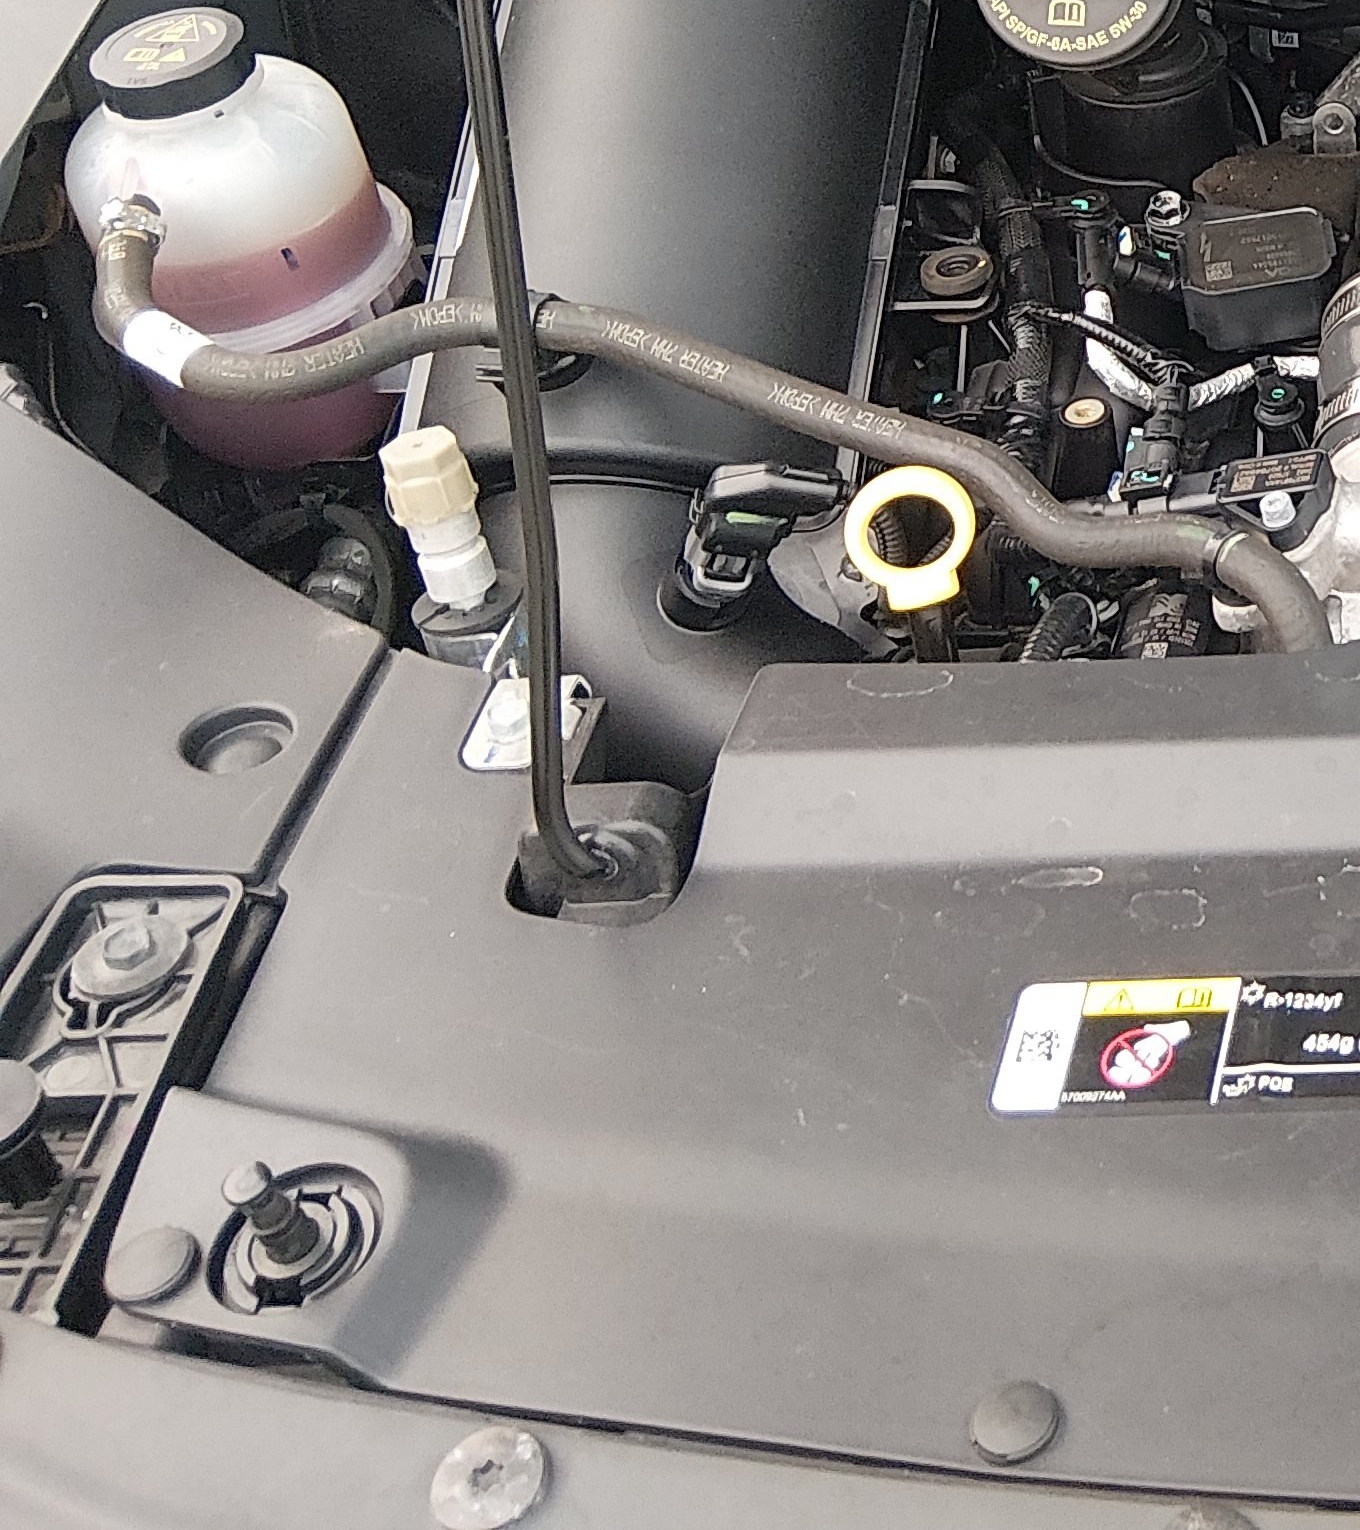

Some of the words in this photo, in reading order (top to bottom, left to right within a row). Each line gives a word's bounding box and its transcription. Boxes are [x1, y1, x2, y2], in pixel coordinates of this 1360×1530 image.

[1108, 0, 1148, 39] 5W-30
[303, 335, 366, 374] HEATER
[677, 349, 730, 384] HEATER
[1263, 989, 1344, 1013] R-1234yf
[1302, 1031, 1355, 1055] 454g
